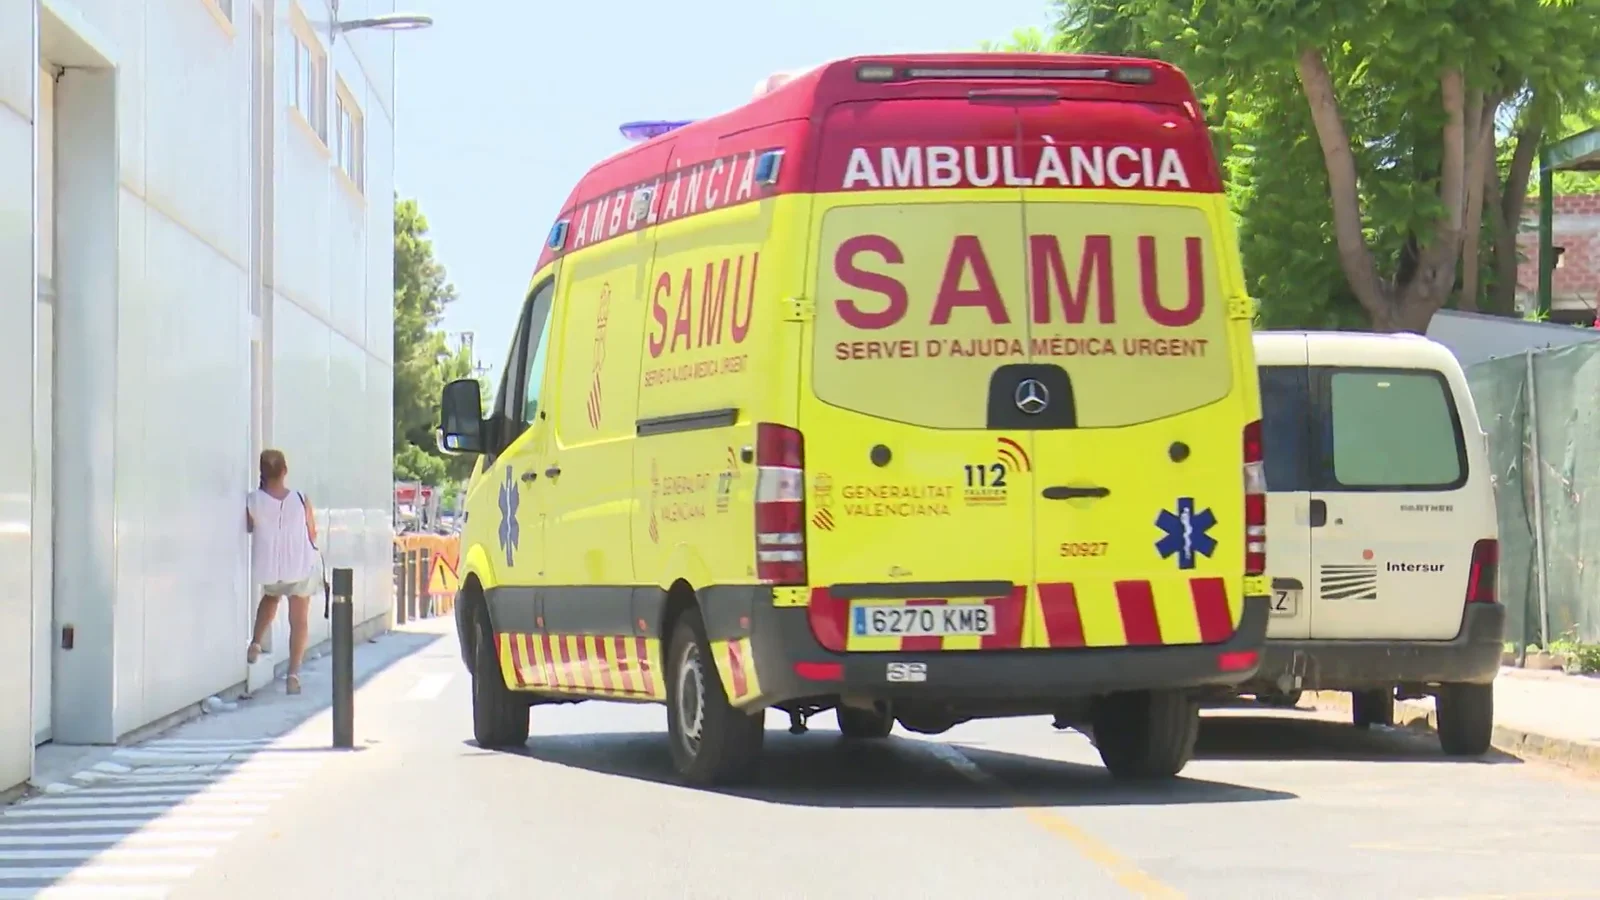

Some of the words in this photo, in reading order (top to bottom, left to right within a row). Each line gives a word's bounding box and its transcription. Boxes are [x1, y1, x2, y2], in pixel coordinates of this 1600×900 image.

[842, 135, 1191, 188] AMBULÀNCIA
[834, 234, 1205, 330] SAMU
[649, 252, 759, 358] SAMU
[835, 341, 919, 360] SERVEI
[926, 339, 1025, 357] D'AJUDA
[1031, 334, 1116, 356] MÉDICA
[1123, 338, 1208, 357] URGENT
[964, 463, 1007, 487] 112
[841, 485, 954, 499] GENERALITAT
[843, 503, 951, 517] VALENCIANA
[1060, 542, 1109, 557] 50927
[1386, 561, 1445, 573] Intersur
[872, 609, 934, 632] 6270
[943, 609, 989, 632] KMB
